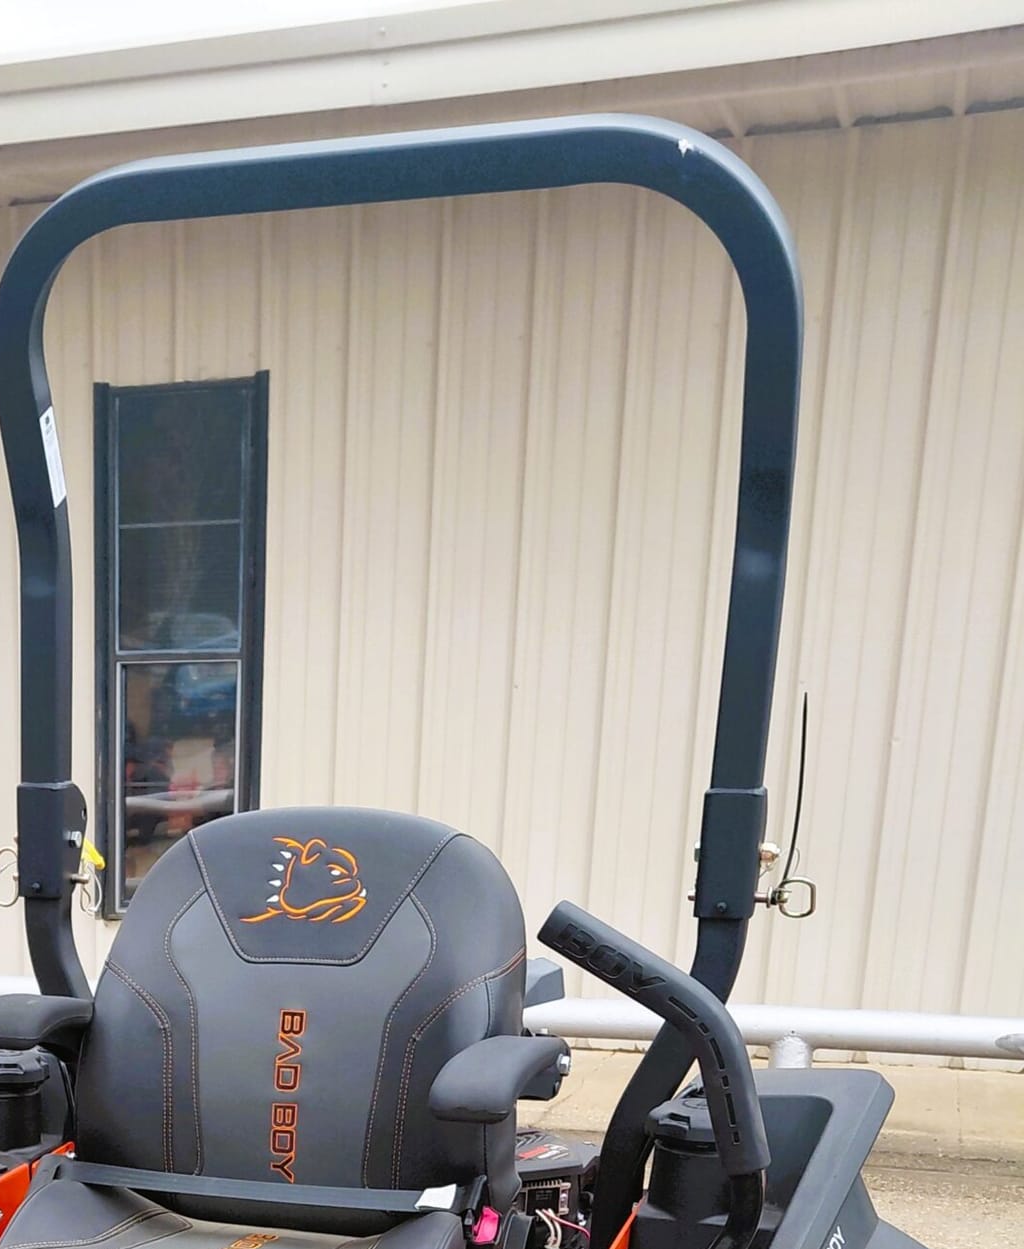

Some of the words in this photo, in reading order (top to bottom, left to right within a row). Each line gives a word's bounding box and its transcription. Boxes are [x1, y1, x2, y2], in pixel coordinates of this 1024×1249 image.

[553, 922, 666, 993] BOY
[275, 1009, 306, 1092] BAD
[270, 1102, 298, 1184] BOY
